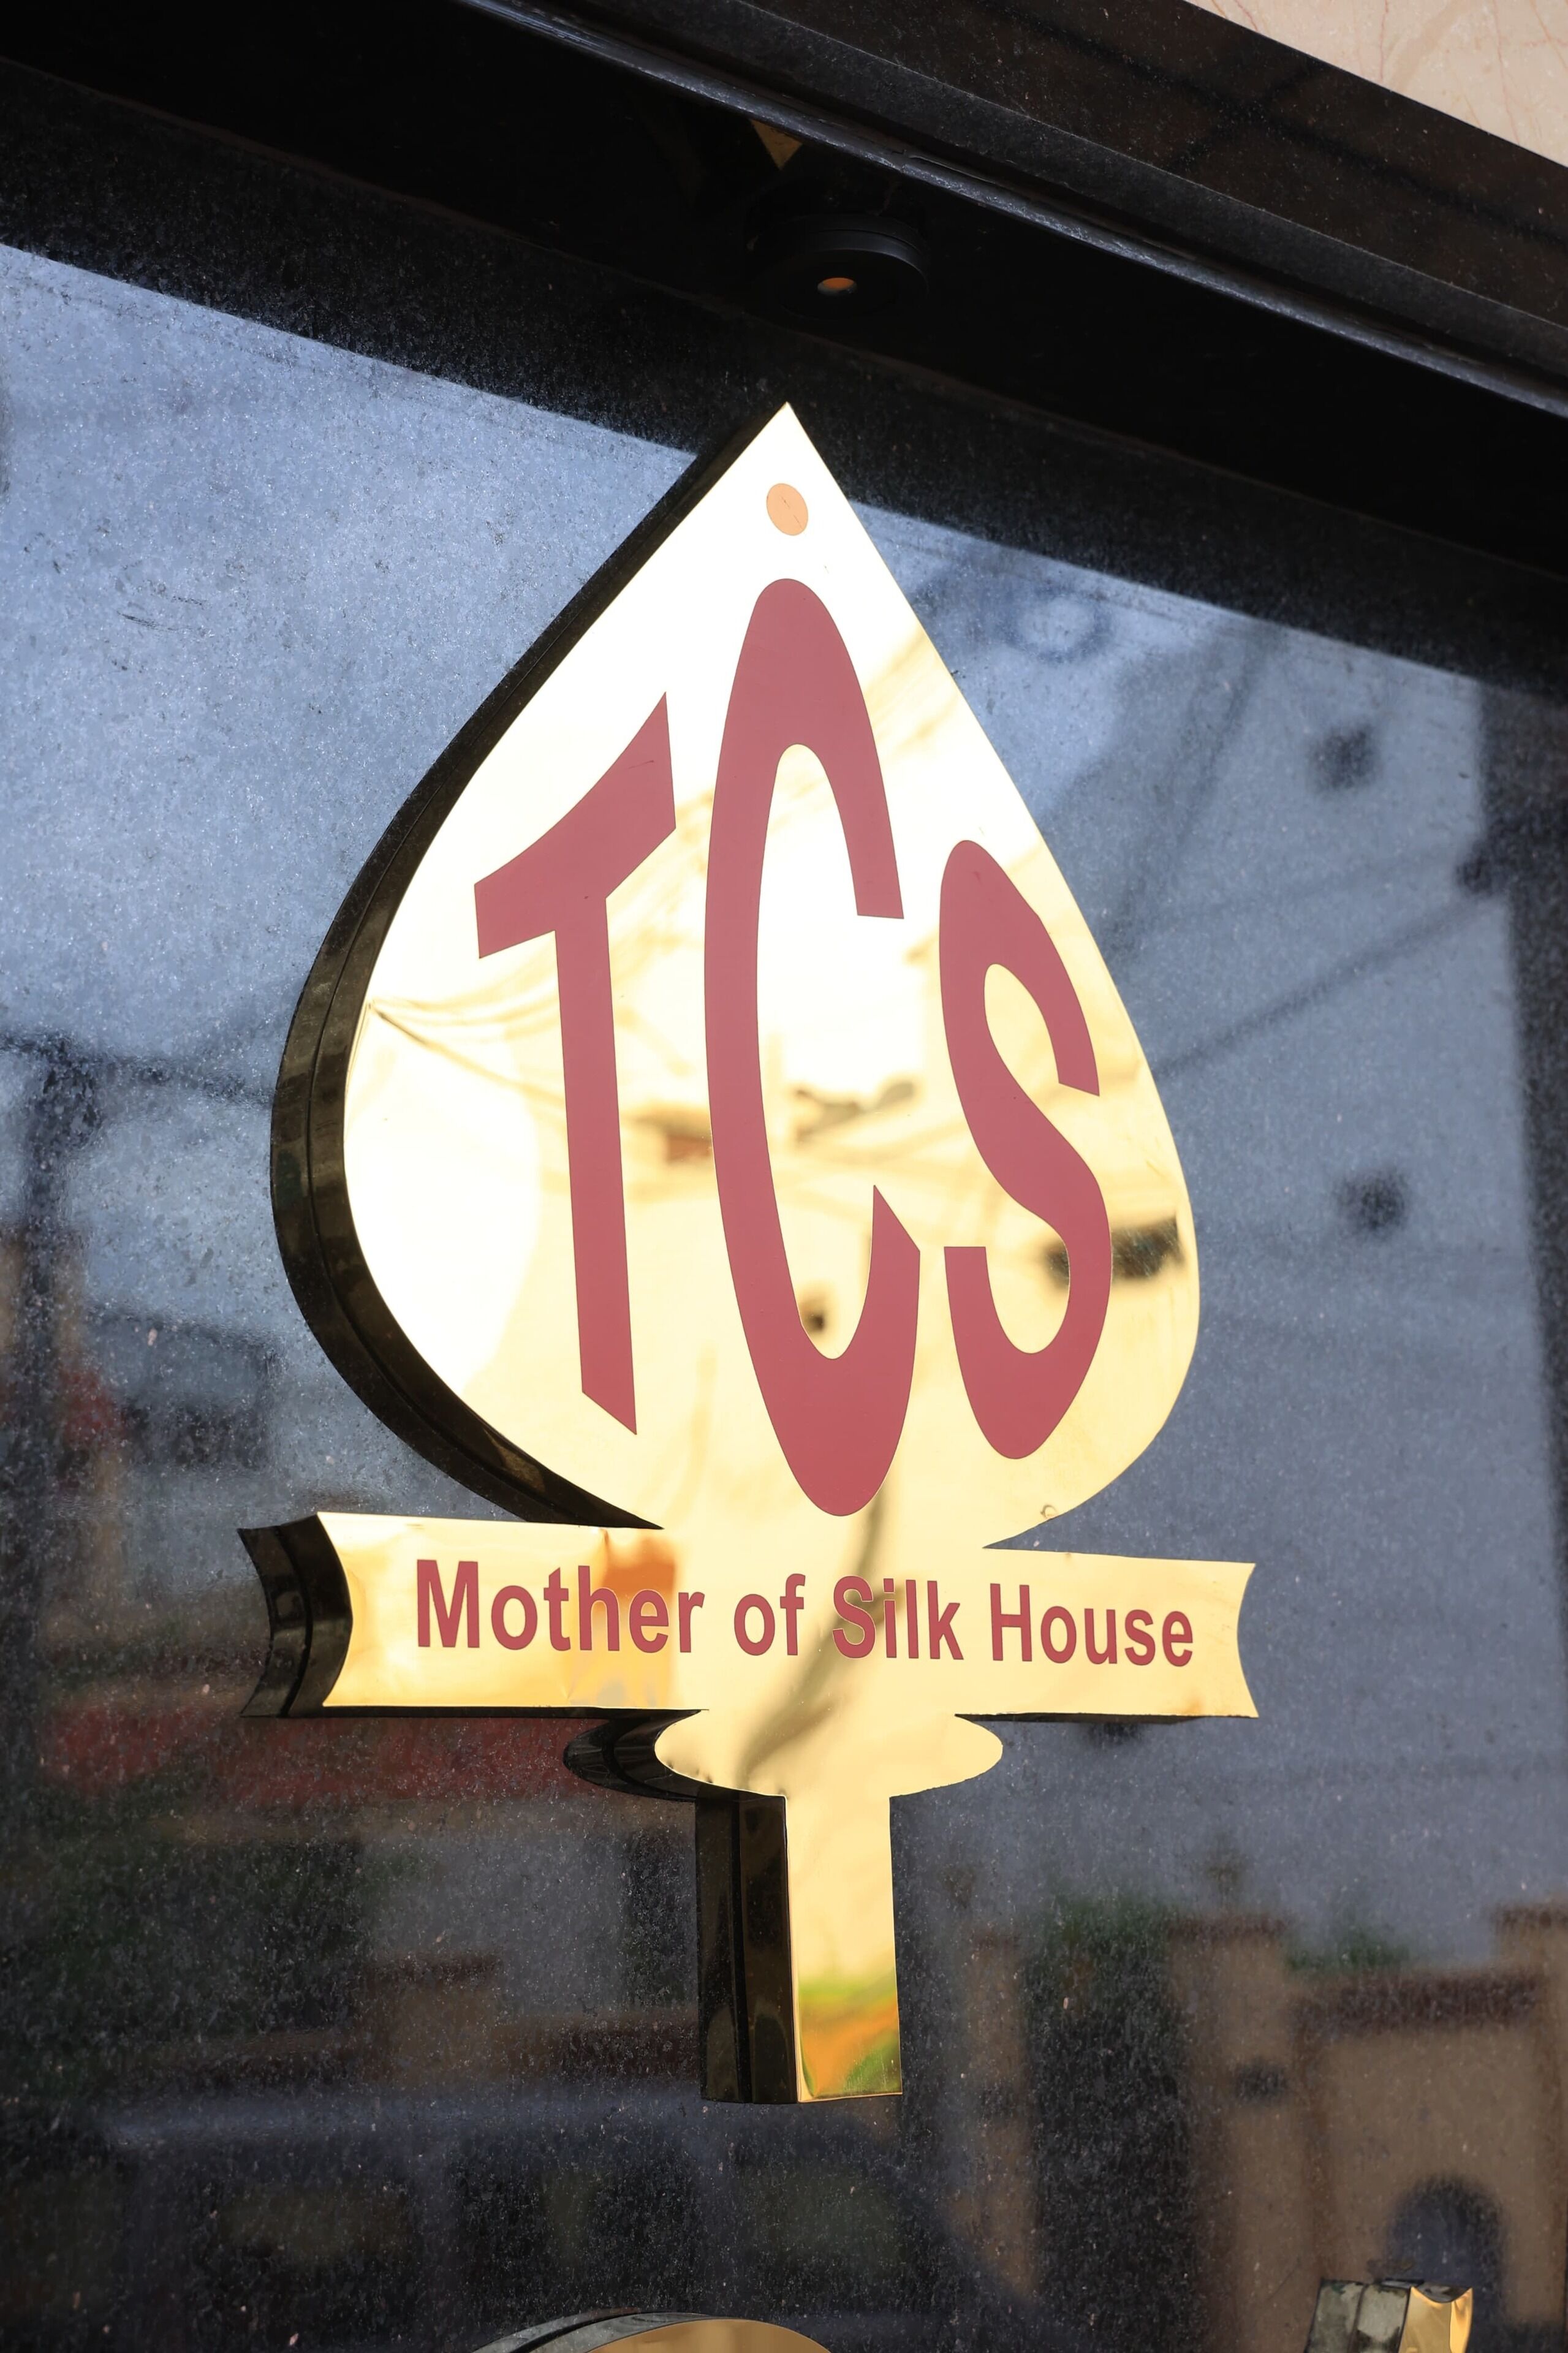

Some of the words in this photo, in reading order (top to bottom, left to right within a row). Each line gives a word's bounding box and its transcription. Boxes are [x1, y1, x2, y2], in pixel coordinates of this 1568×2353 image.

[474, 579, 1112, 1516] TCS
[417, 1559, 704, 1653] Mother
[734, 1574, 805, 1656] of
[833, 1575, 963, 1660] Silk
[990, 1583, 1193, 1666] House
